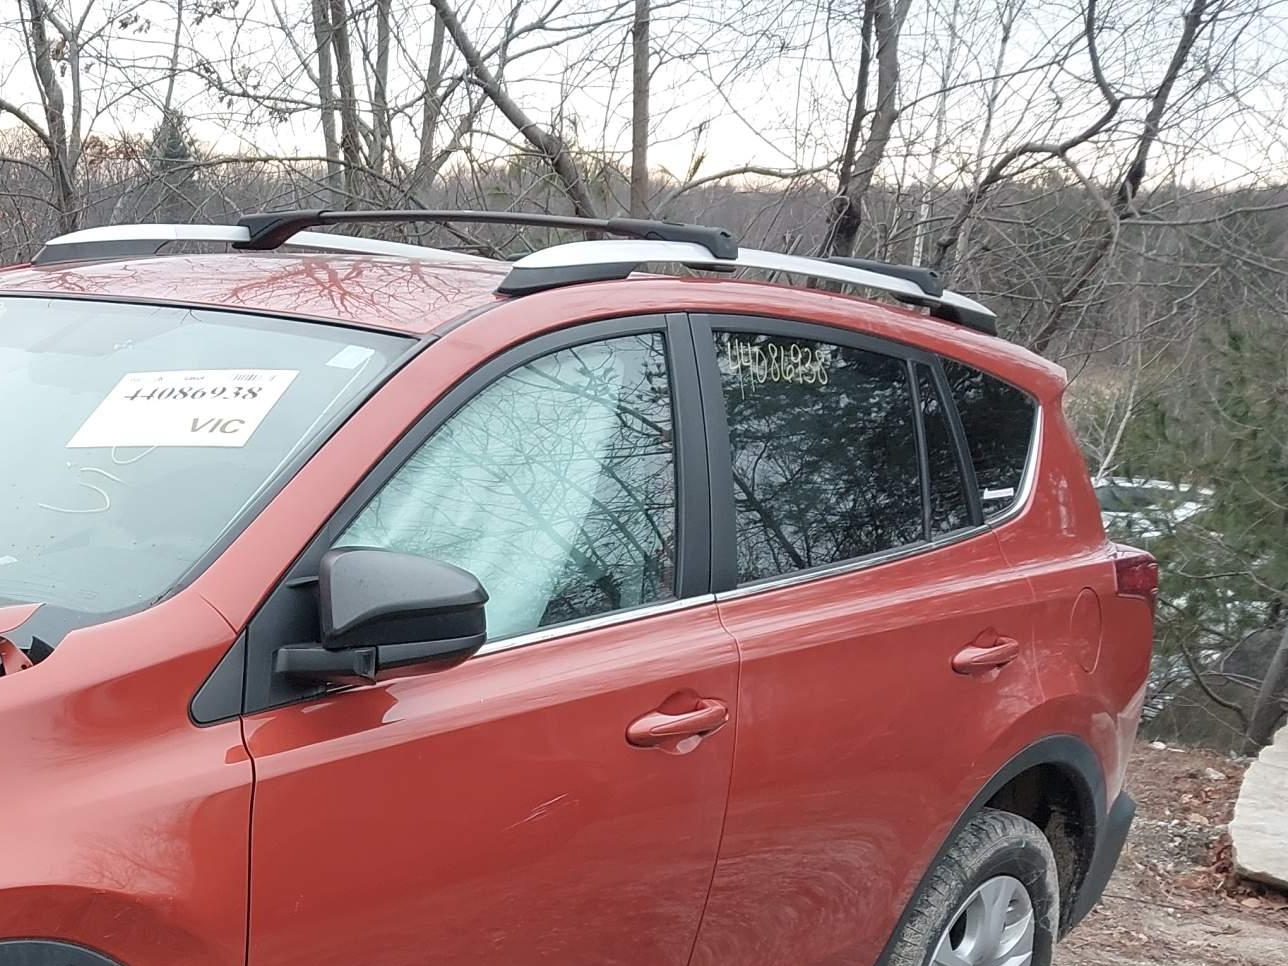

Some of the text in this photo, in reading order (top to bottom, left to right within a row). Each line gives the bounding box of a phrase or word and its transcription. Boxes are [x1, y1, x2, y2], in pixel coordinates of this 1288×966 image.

[727, 338, 828, 401] 44086938
[123, 386, 263, 400] 44086938
[190, 417, 246, 434] VIC
